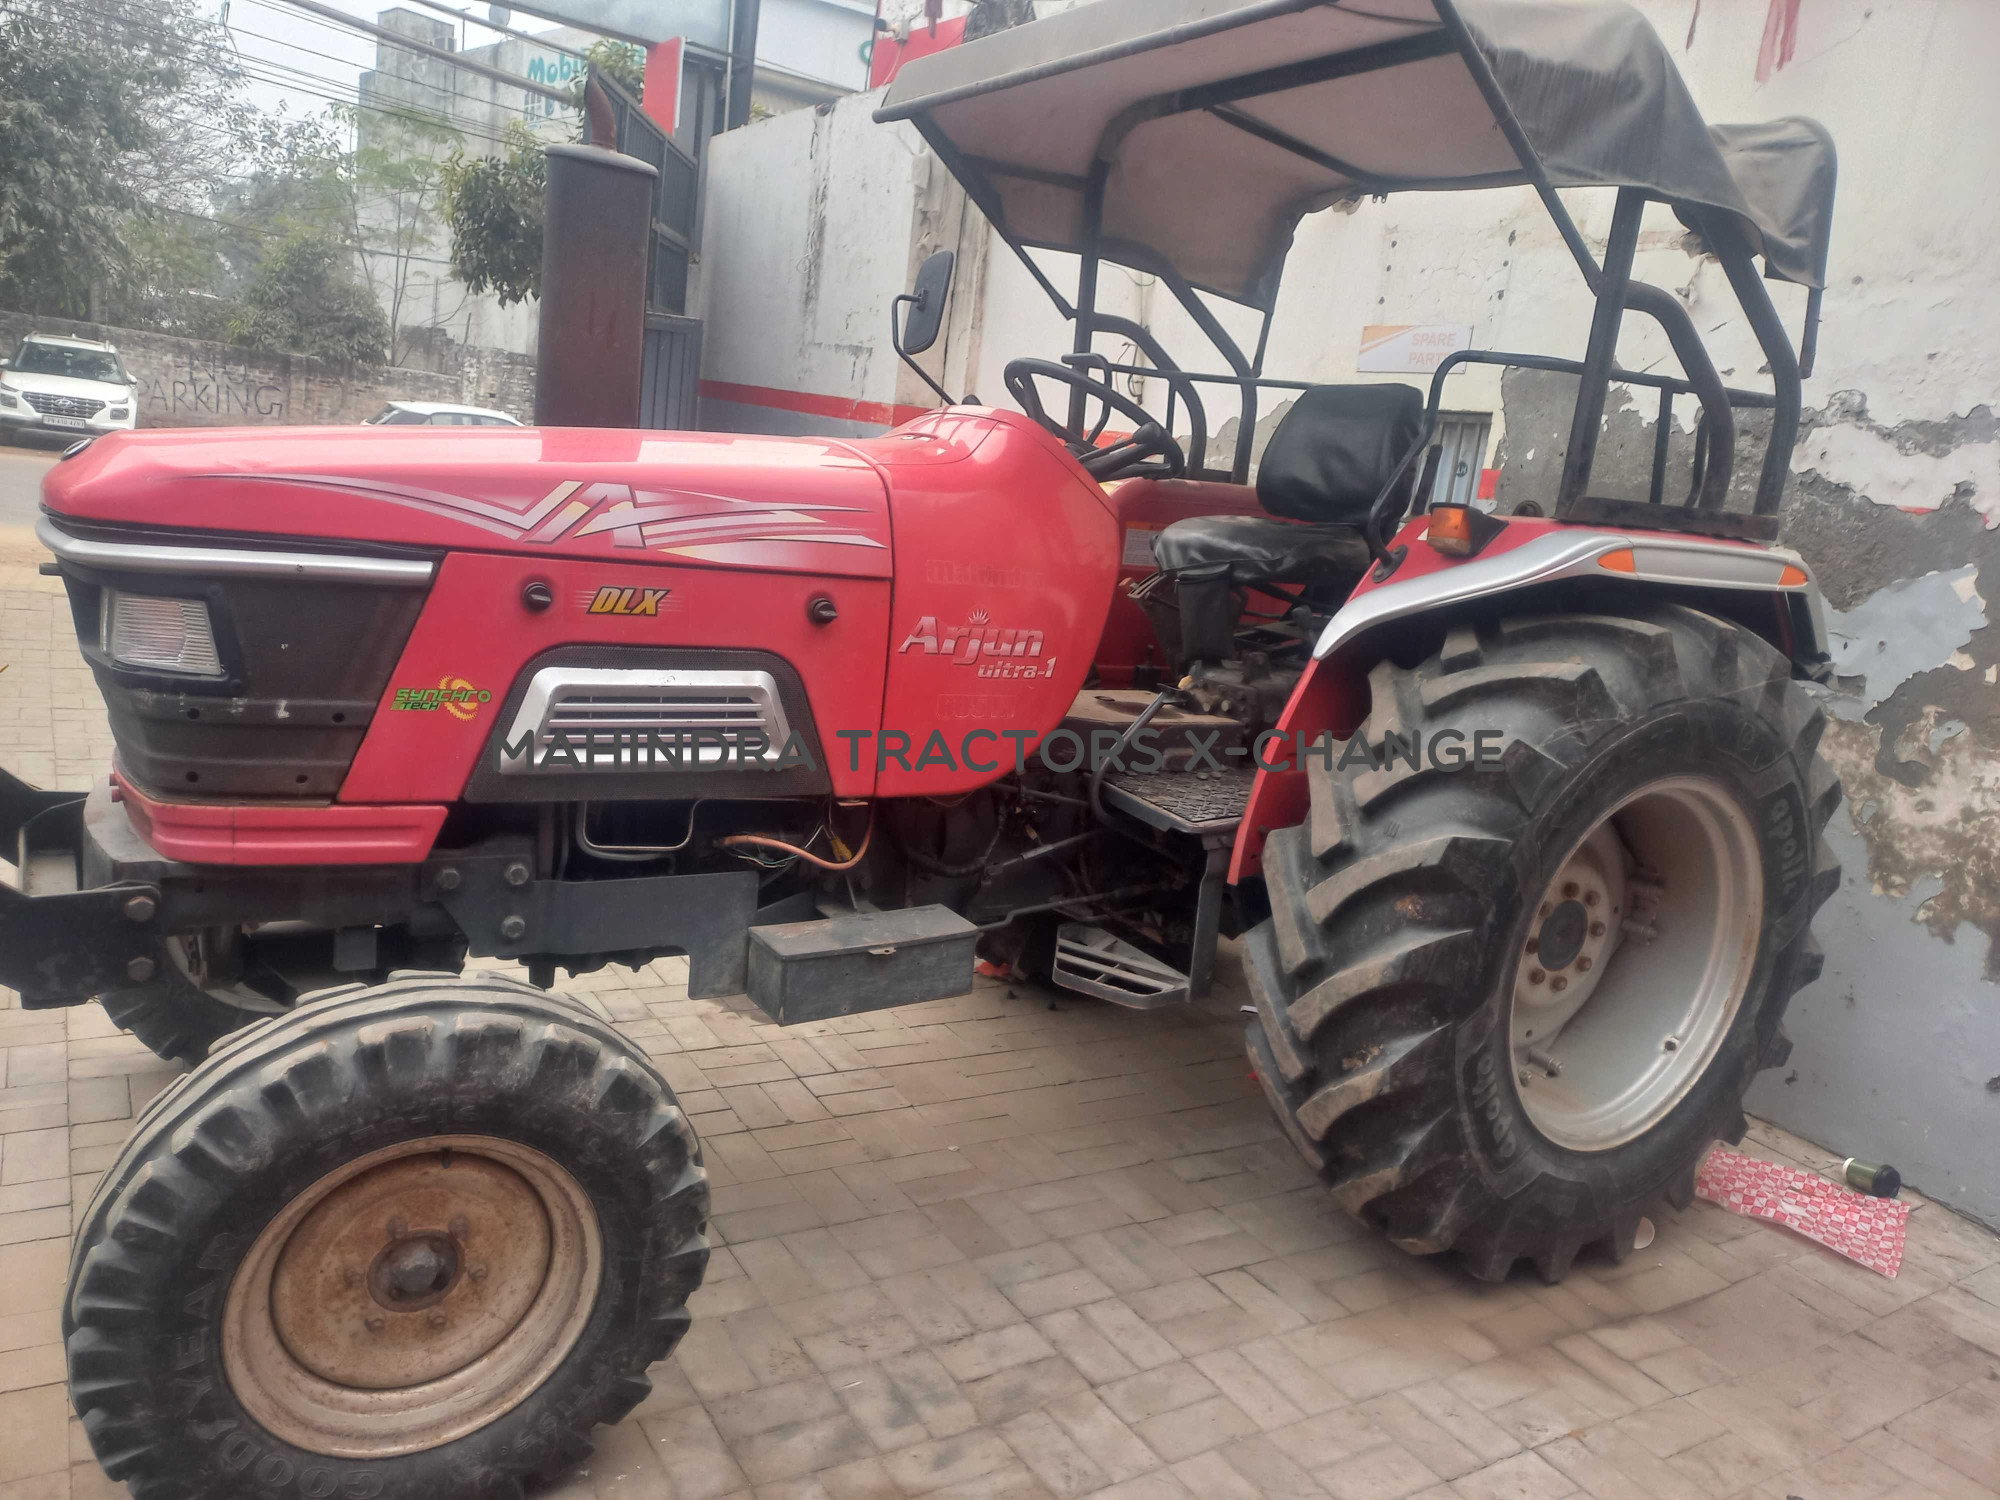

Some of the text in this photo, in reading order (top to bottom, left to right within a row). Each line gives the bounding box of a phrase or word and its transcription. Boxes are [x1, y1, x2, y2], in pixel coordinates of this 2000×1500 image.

[1411, 332, 1457, 347] SPARE
[586, 586, 672, 617] DLX
[898, 612, 1045, 666] Arjun
[977, 657, 1057, 680] ultra-1
